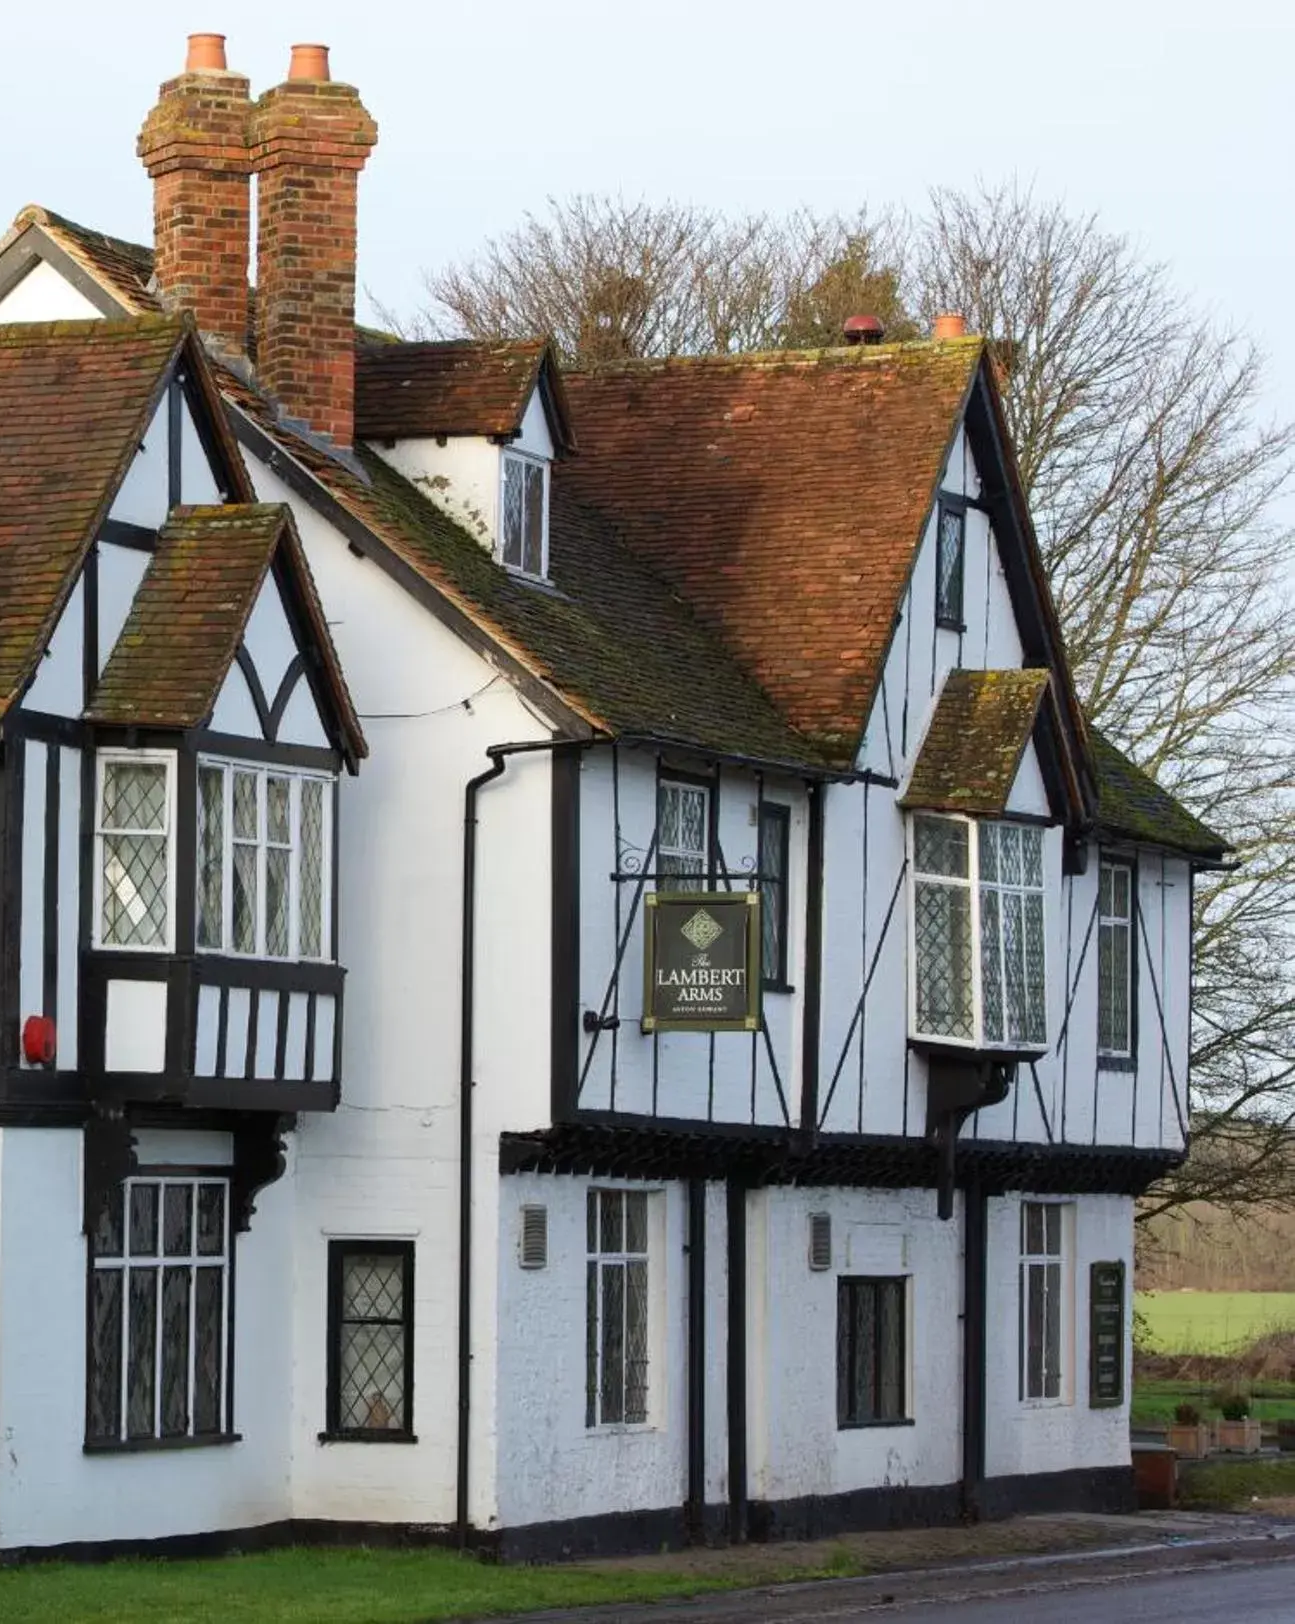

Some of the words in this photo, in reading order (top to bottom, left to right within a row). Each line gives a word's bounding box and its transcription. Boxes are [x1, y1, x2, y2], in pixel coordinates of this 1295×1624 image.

[691, 953, 711, 967] The
[658, 969, 745, 985] LAMBERT
[677, 987, 723, 1001] ARMS
